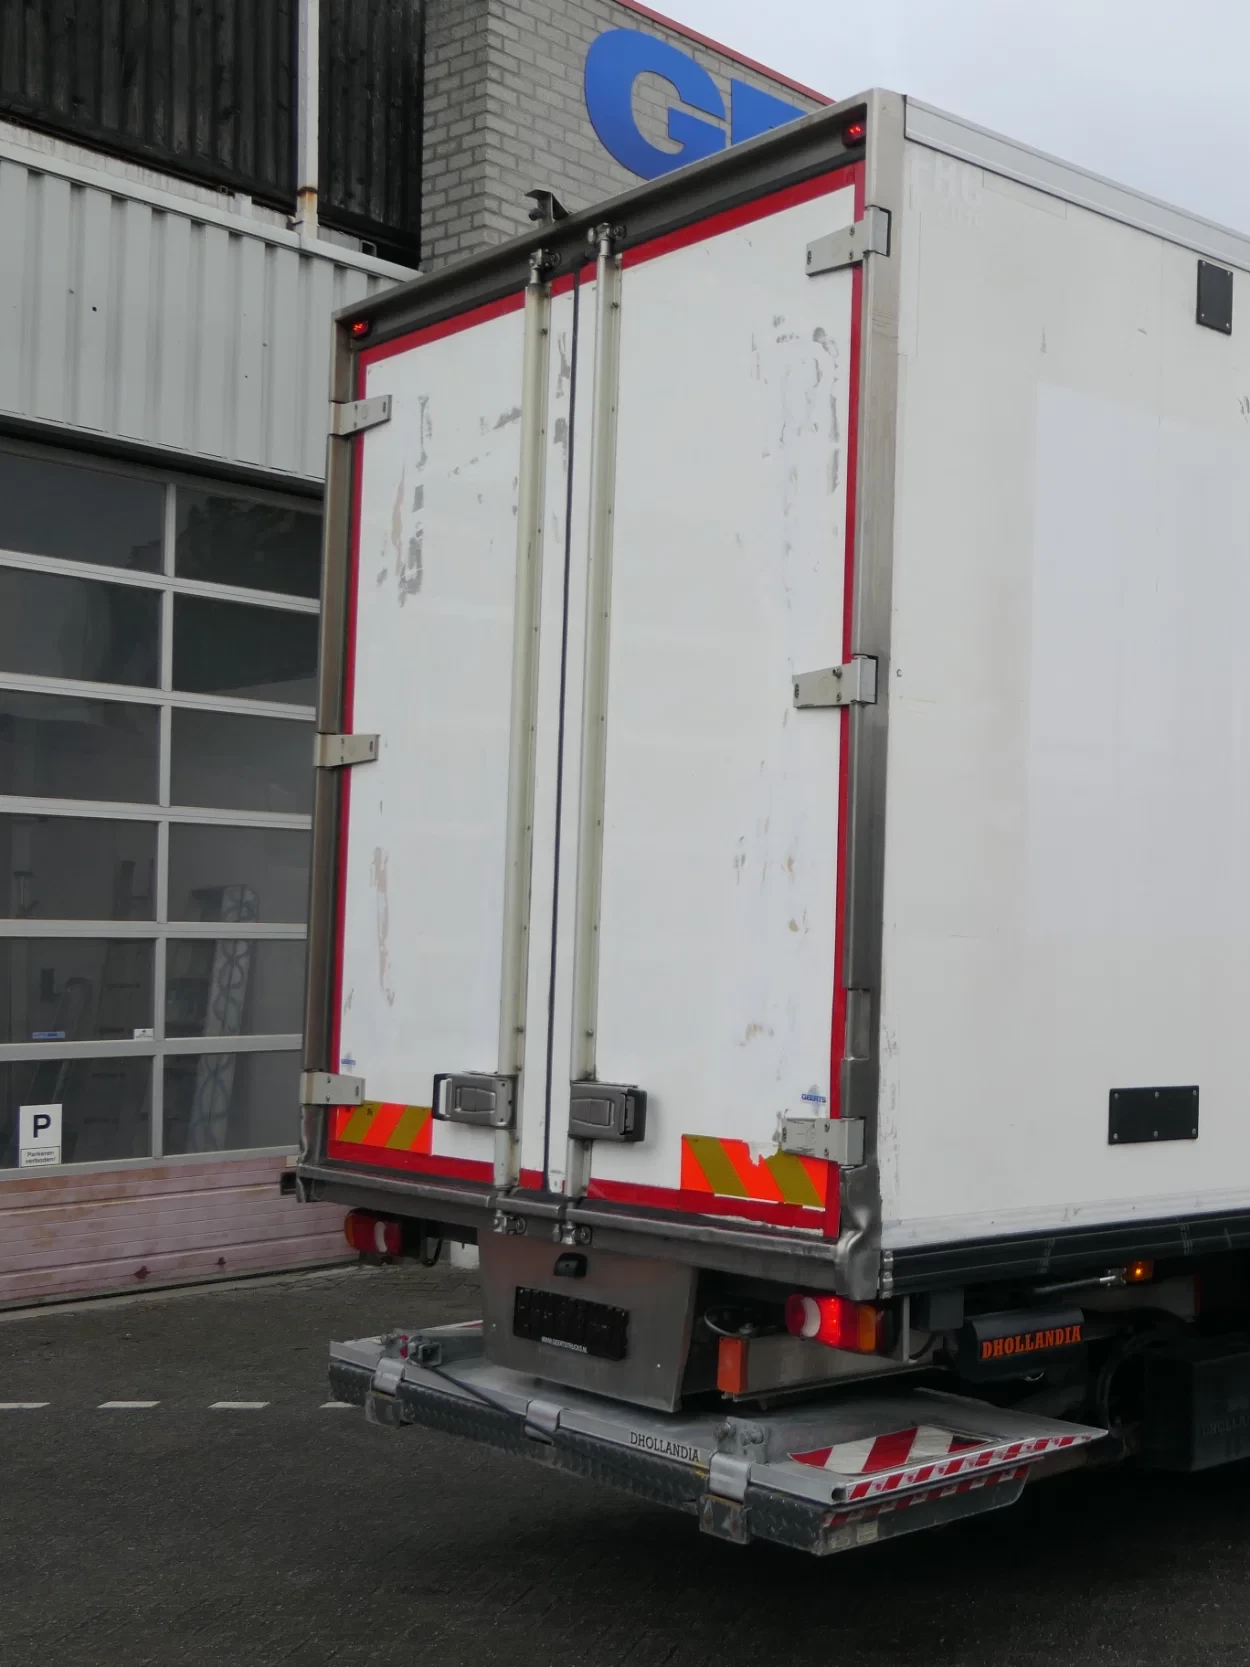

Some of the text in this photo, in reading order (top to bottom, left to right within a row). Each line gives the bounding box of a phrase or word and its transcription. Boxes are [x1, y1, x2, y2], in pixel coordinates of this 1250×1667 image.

[801, 1093, 827, 1103] GEERTS
[33, 1114, 51, 1138] P
[981, 1325, 1082, 1360] DHOLLANDIA
[630, 1431, 700, 1463] DHOLLANDIA
